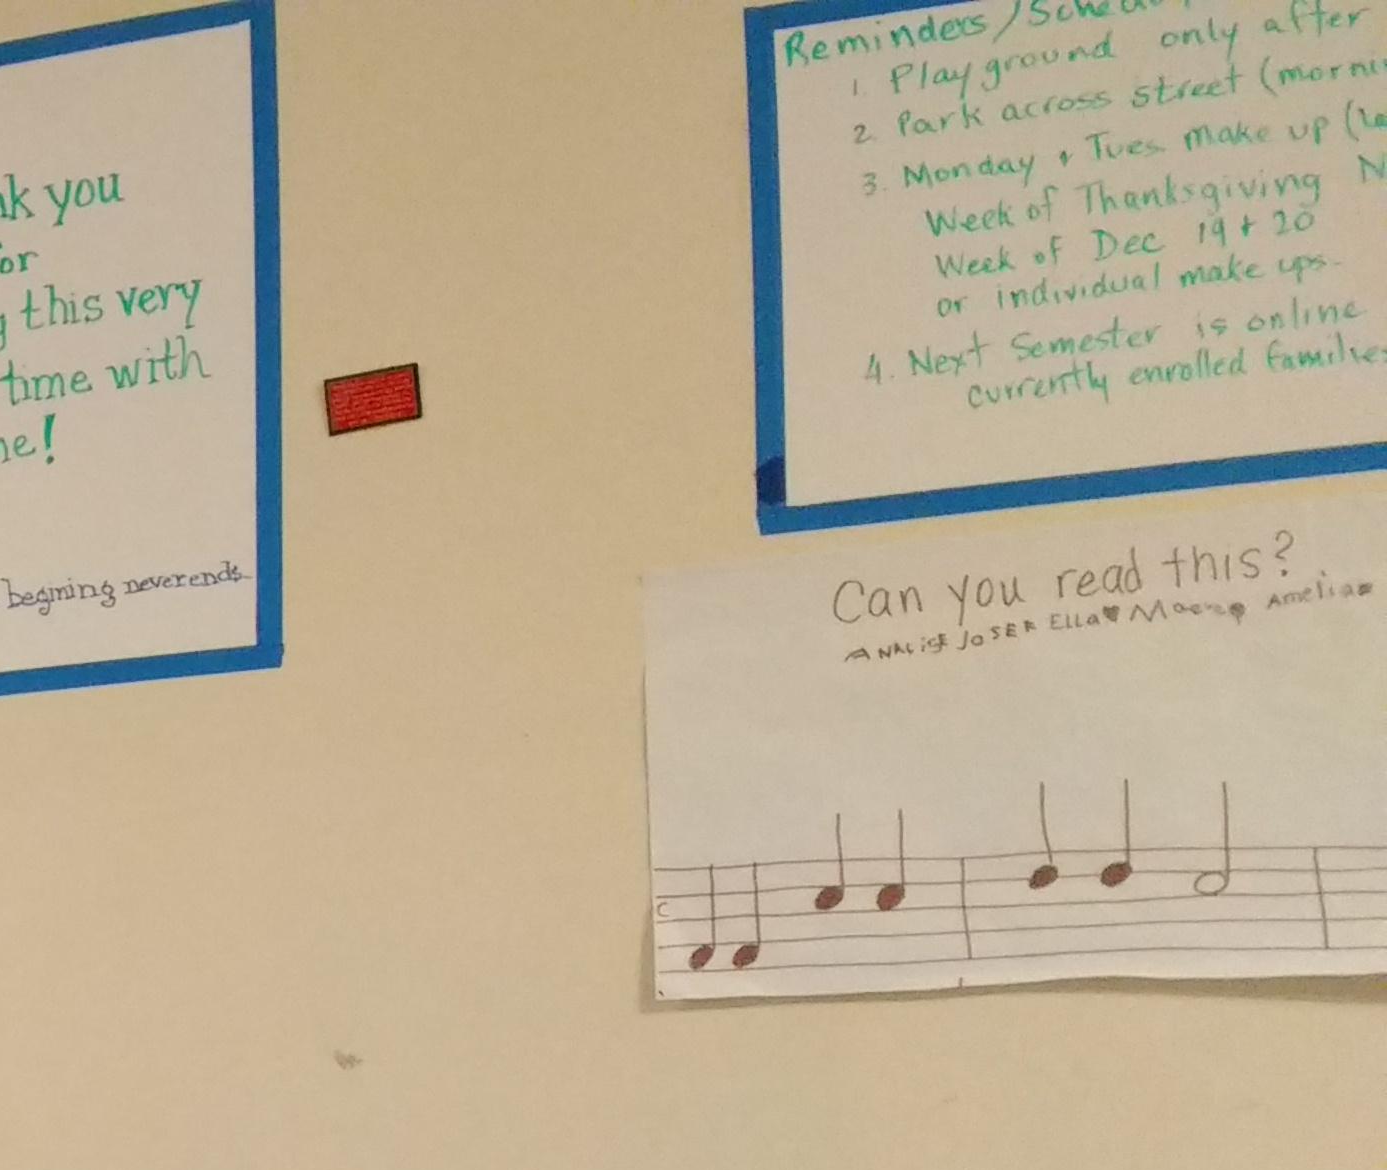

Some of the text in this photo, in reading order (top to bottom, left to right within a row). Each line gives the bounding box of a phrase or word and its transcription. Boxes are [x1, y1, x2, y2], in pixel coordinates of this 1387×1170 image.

[1160, 17, 1239, 61] only
[1265, 0, 1371, 36] after
[1001, 90, 1113, 122] across
[1131, 63, 1243, 109] street
[903, 154, 1036, 188] Monday
[1288, 116, 1331, 145] up
[43, 173, 125, 227] you
[925, 199, 1015, 237] Week
[1027, 185, 1058, 221] of
[1075, 169, 1321, 216] Thanksgiving
[935, 246, 1016, 278] Week
[1034, 235, 1062, 265] of
[1198, 216, 1226, 247] 19
[1273, 210, 1315, 235] 20
[19, 284, 104, 330] this
[115, 279, 202, 329] very
[937, 296, 969, 318] or
[997, 260, 1161, 309] individual
[1179, 252, 1265, 288] make
[104, 334, 212, 390] with
[908, 330, 990, 376] Next
[1197, 314, 1228, 338] is
[1247, 297, 1366, 332] online
[968, 360, 1110, 409] currently
[1129, 349, 1246, 385] enrolled
[832, 578, 925, 626] Can
[945, 573, 1027, 626] you
[1054, 547, 1144, 597] read
